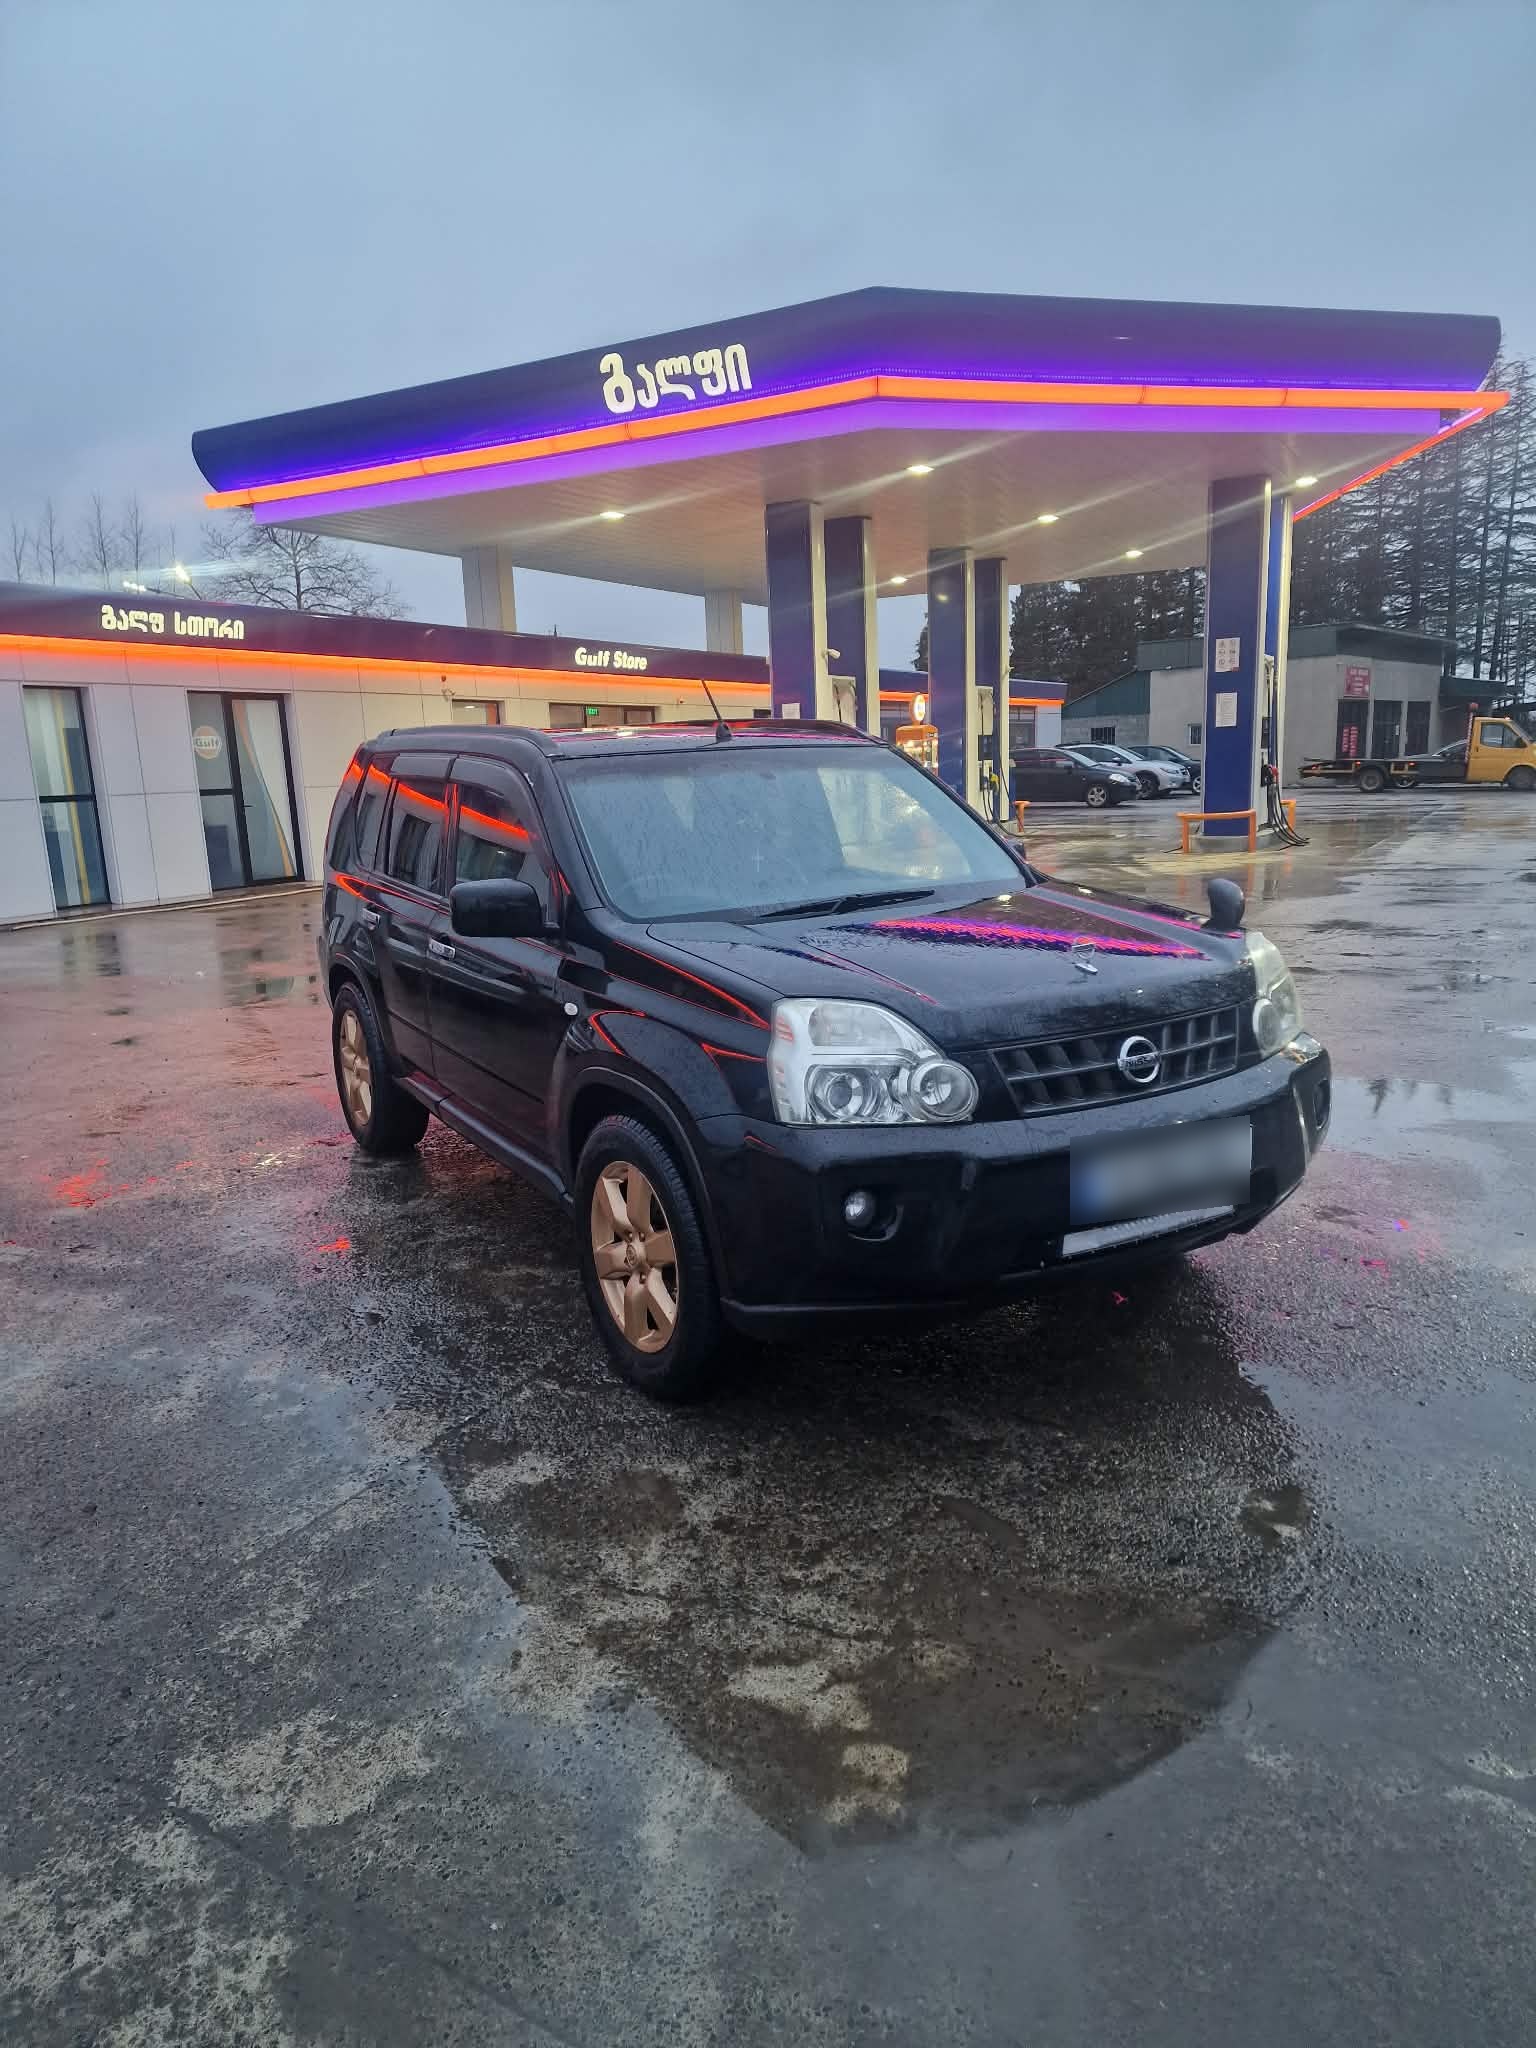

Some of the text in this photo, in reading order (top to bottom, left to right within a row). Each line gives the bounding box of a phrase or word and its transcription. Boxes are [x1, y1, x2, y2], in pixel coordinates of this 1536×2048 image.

[600, 343, 753, 414] გალფი
[101, 604, 245, 640] გალფ სთორი
[575, 647, 647, 670] Gulf Store
